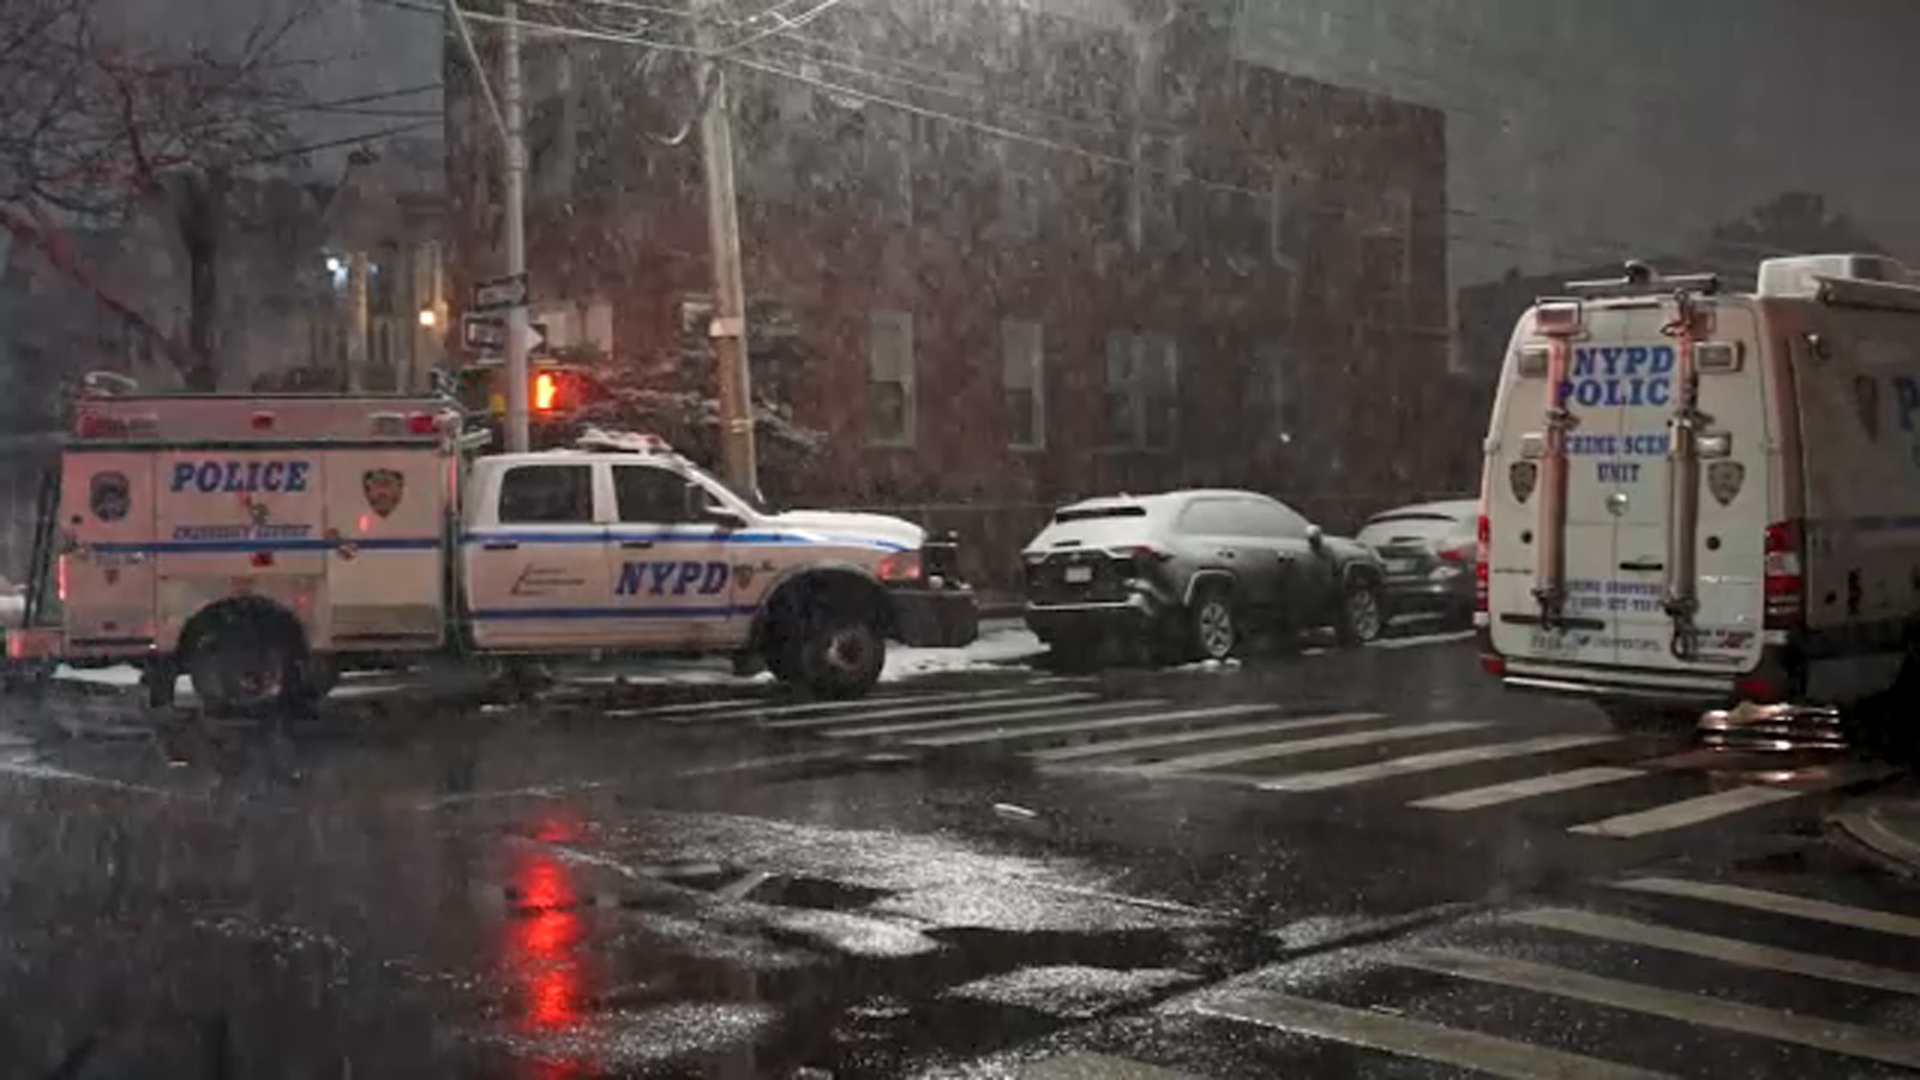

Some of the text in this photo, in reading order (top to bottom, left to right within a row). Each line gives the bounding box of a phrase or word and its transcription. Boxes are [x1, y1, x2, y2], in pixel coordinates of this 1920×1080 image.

[1573, 346, 1675, 376] NYPD
[1557, 379, 1670, 407] POLIC
[1624, 434, 1669, 455] SCEN
[170, 461, 310, 492] POLICE
[1597, 463, 1641, 482] UNIT
[615, 561, 729, 596] NYPD
